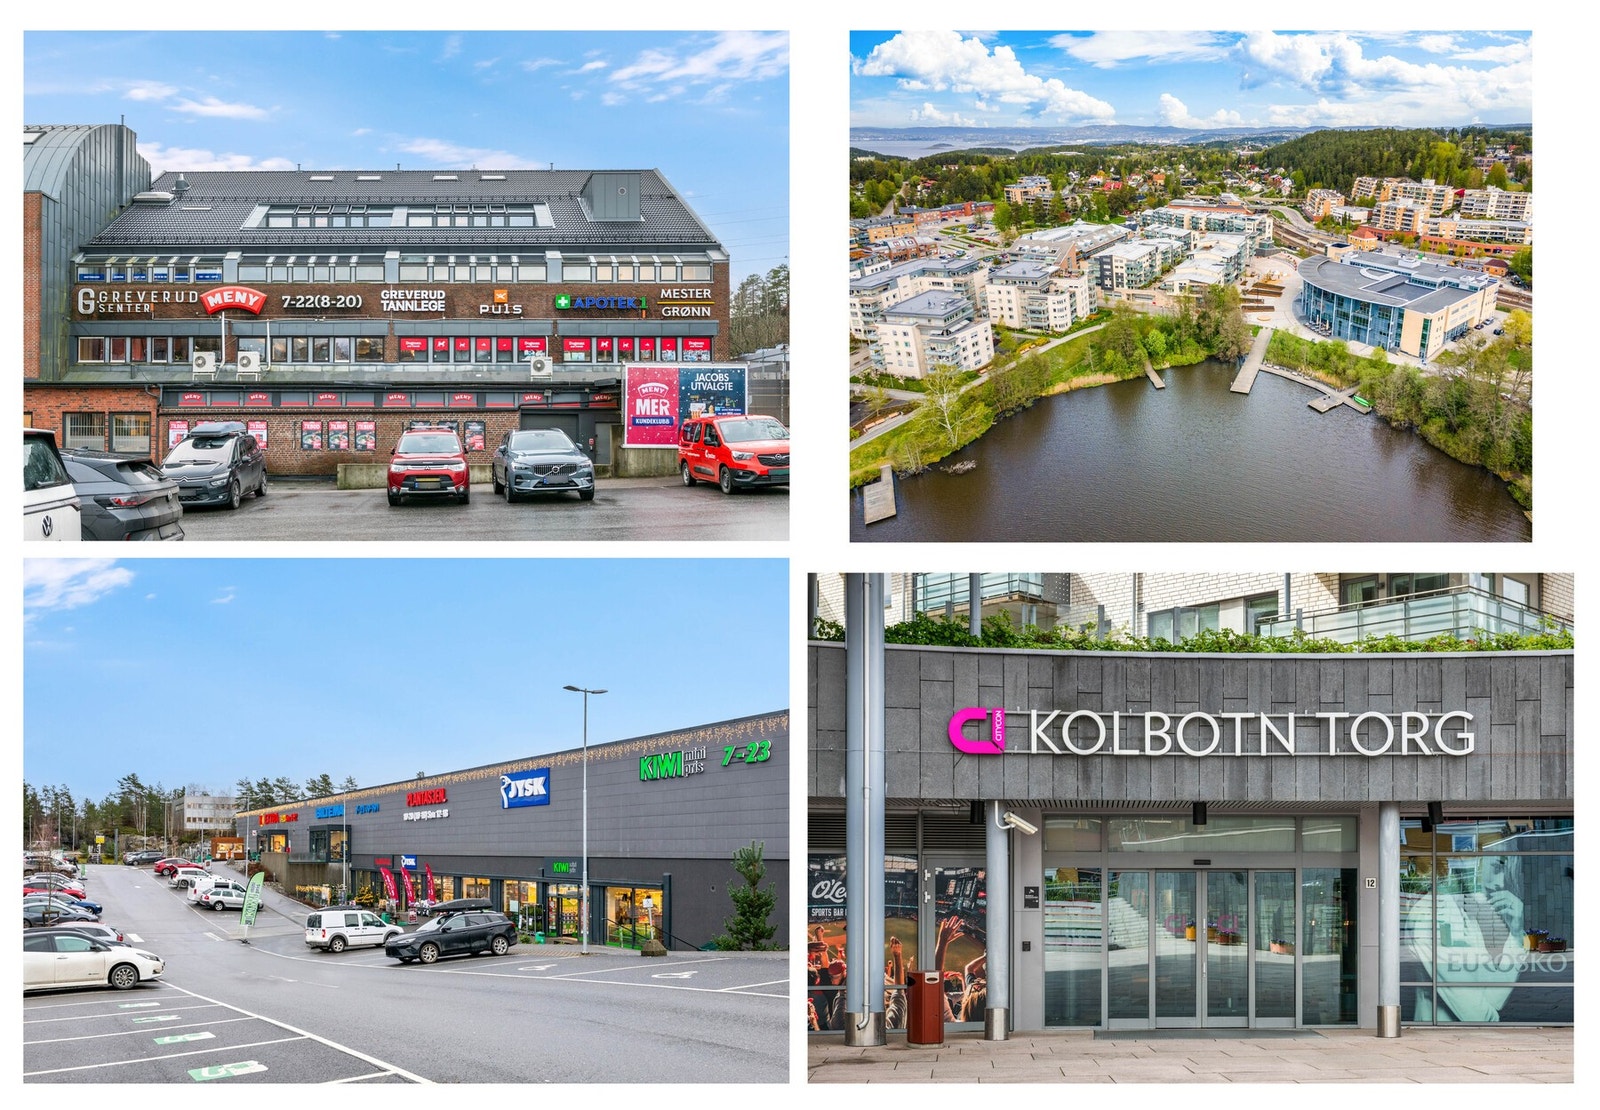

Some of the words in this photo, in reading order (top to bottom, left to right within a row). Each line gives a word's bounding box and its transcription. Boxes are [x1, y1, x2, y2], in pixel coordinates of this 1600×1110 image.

[98, 290, 198, 303] GREVERUD
[207, 290, 260, 308] MENY
[381, 289, 446, 300] GREVERUD
[660, 288, 712, 299] MESTER
[281, 294, 363, 309] 7-22(8-20)
[381, 300, 446, 312] TANNLEGE
[573, 296, 637, 309] APOTEK
[638, 296, 648, 309] 1
[98, 303, 150, 313] SENTER
[661, 305, 711, 317] GRØNN
[694, 372, 730, 382] JACOBS
[641, 385, 665, 395] MENY
[690, 382, 734, 391] UTVALGTE
[525, 393, 542, 401] MENY
[635, 398, 670, 416] MER
[635, 417, 670, 425] KUNDEKLUBB
[995, 710, 1003, 742] CITYCON
[1030, 709, 1296, 756] KOLBOTN
[1315, 710, 1475, 756] TORG
[720, 740, 772, 767] 7-23
[639, 751, 684, 781] KIWI
[684, 746, 707, 761] mini
[684, 760, 705, 777] pris
[509, 776, 547, 799] JYSK
[553, 862, 569, 873] KIWI
[1367, 879, 1375, 888] 12
[811, 878, 848, 904] O'Le
[811, 908, 832, 917] SPORTS
[833, 908, 845, 917] BAR
[1446, 951, 1568, 974] EUROSKO
